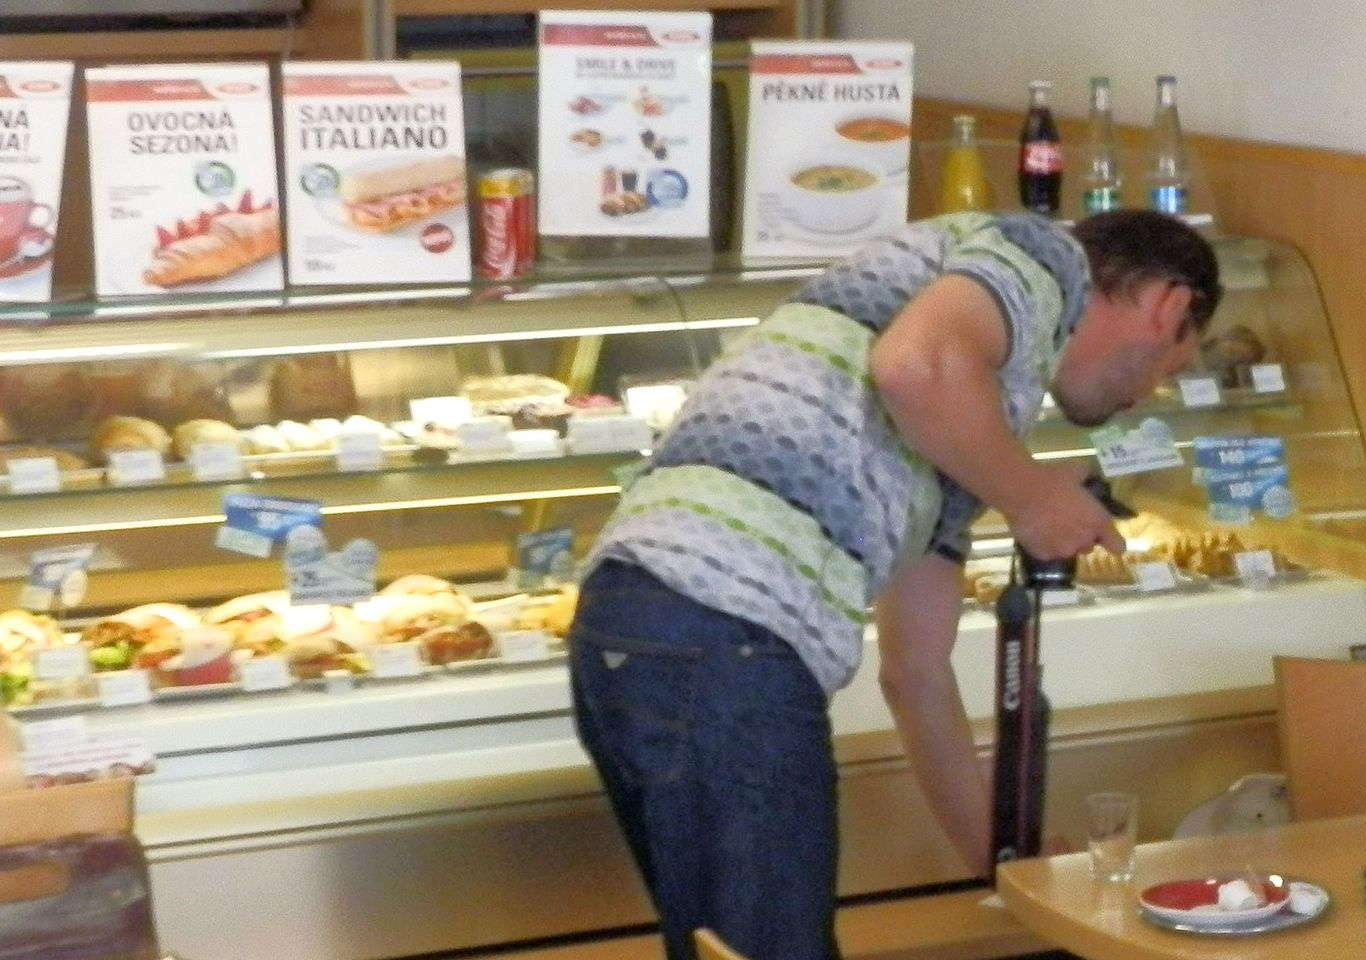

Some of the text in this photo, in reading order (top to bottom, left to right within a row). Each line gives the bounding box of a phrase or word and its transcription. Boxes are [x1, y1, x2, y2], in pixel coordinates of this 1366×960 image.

[299, 103, 447, 124] SANDWICH
[300, 126, 448, 150] ITALIANO
[1004, 640, 1022, 711] Canon
